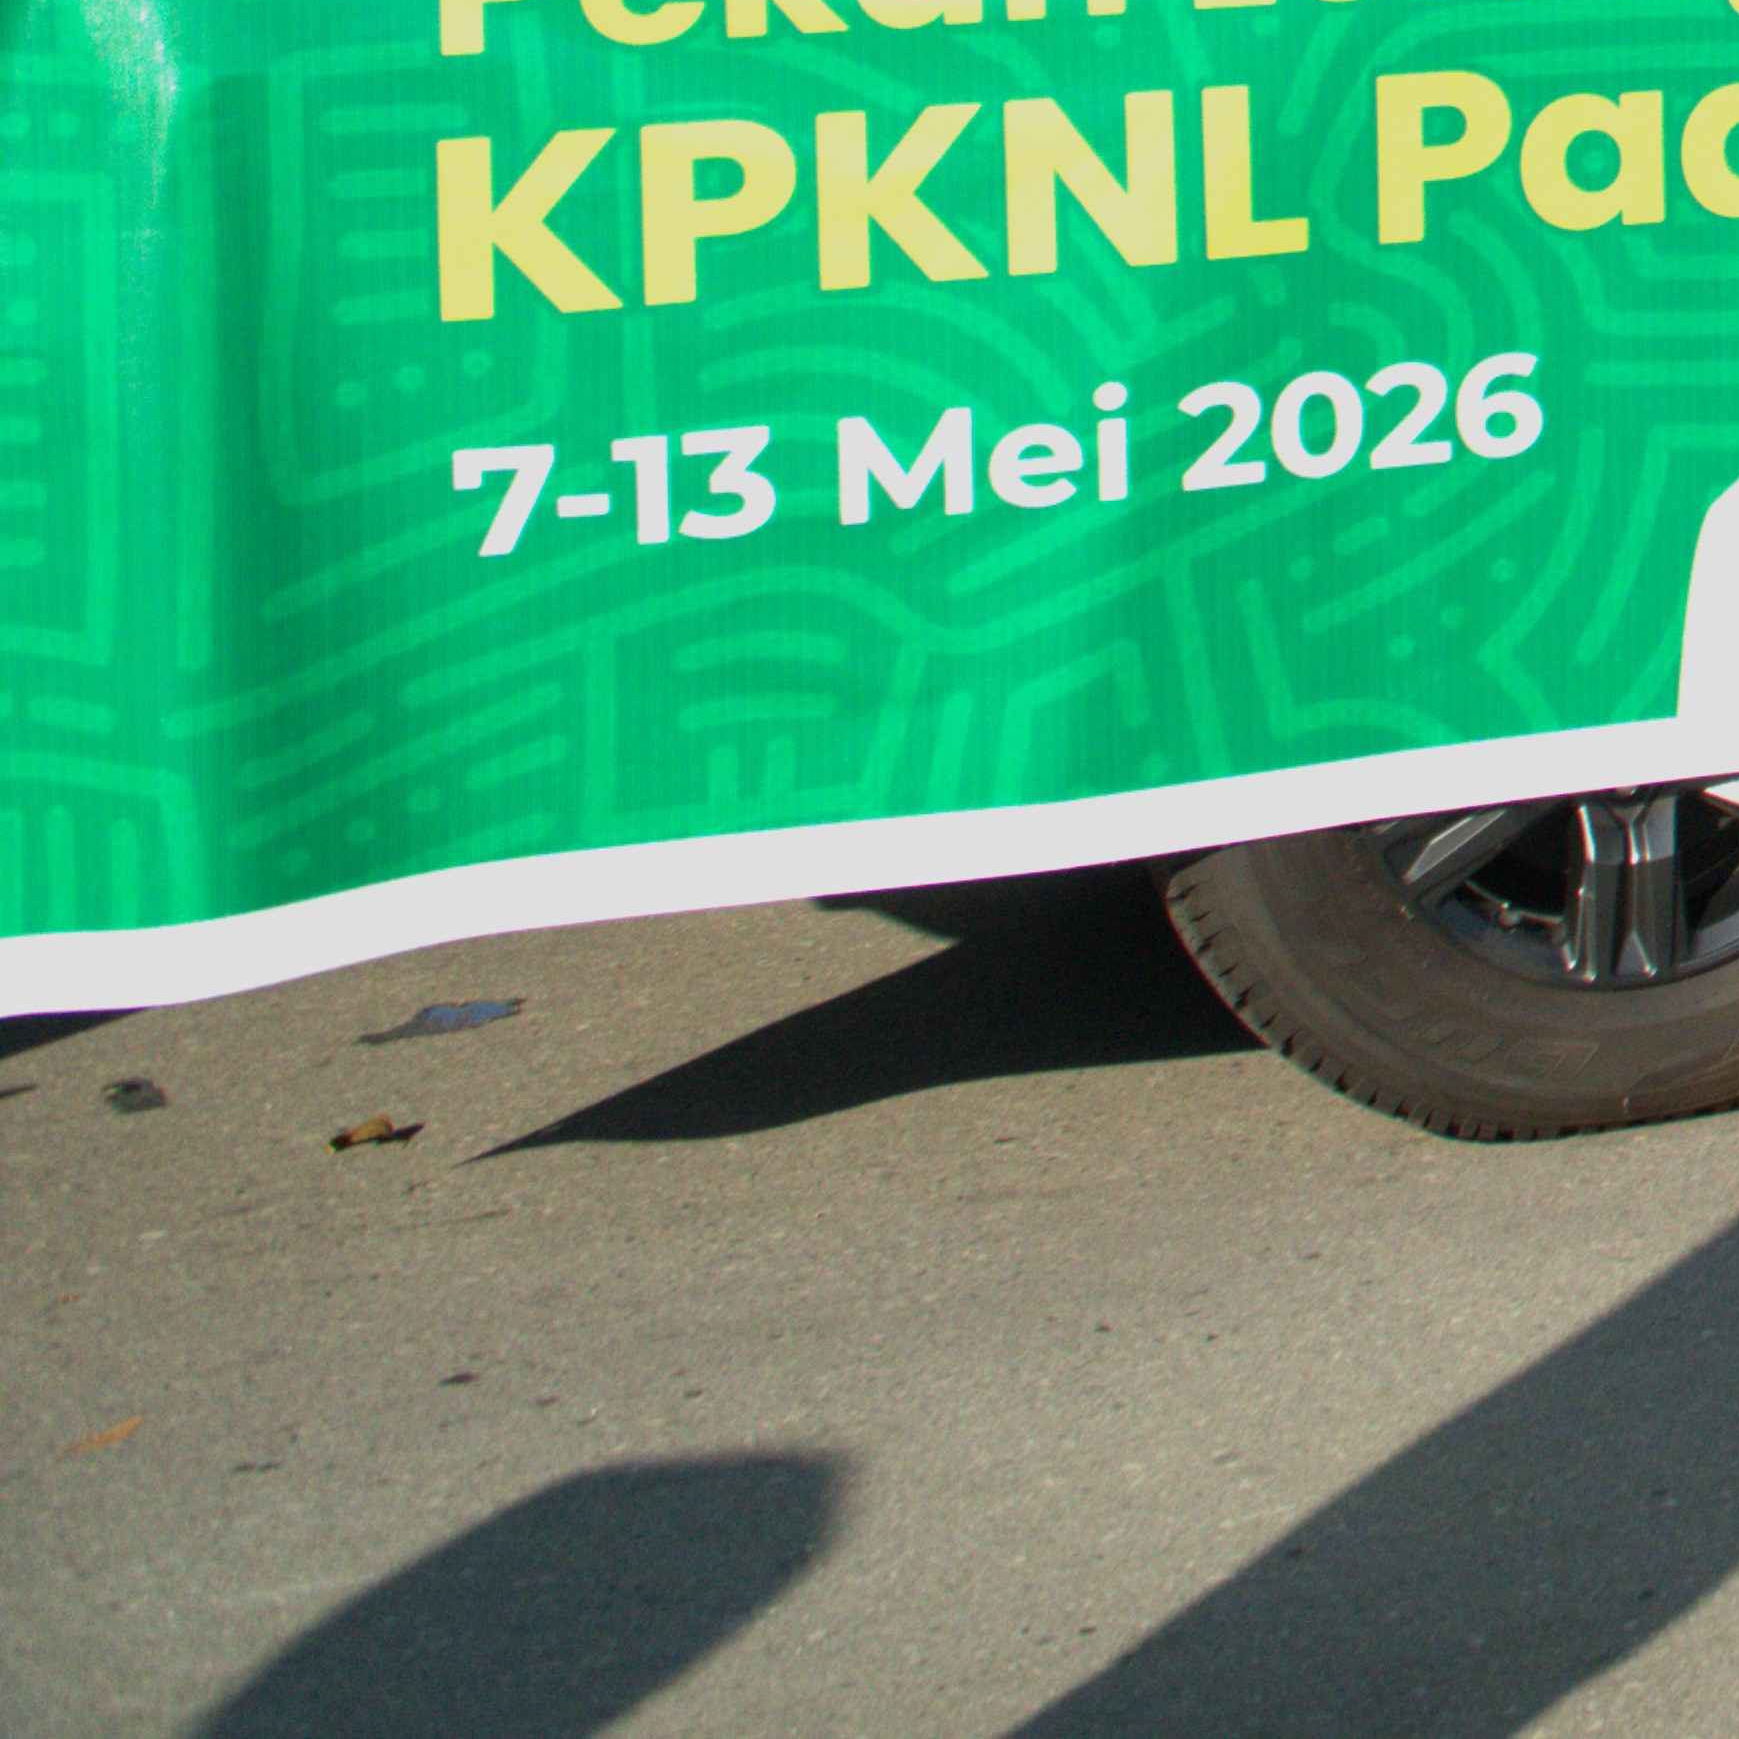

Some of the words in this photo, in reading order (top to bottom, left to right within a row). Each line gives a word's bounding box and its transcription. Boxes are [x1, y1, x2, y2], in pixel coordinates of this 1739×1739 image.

[436, 85, 1308, 322] KPKNL
[452, 425, 776, 557] 7-13
[837, 384, 1128, 525] Mei
[1178, 352, 1543, 491] 2026
